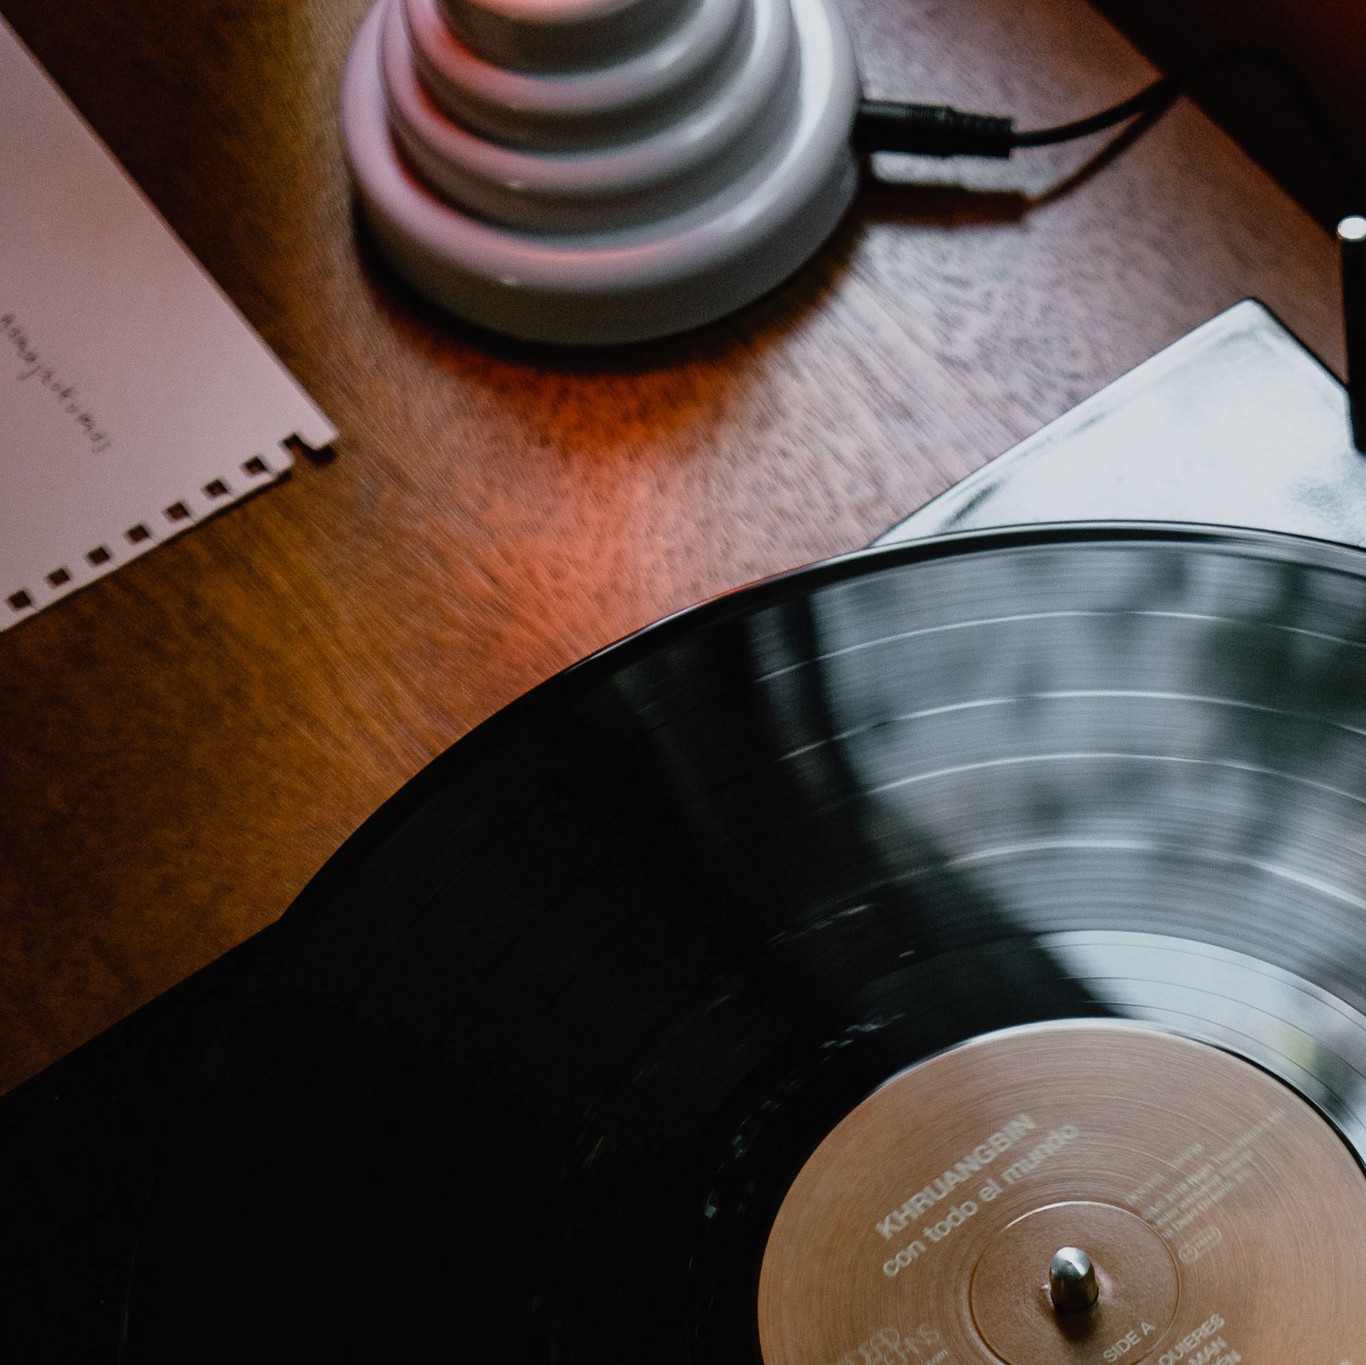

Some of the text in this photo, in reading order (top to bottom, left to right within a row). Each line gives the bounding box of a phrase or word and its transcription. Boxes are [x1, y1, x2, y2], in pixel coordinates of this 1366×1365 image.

[877, 1115, 1035, 1240] KHRUANGBIN
[883, 1126, 1078, 1277] con todo el mundo
[1103, 1321, 1155, 1363] SIDE A
